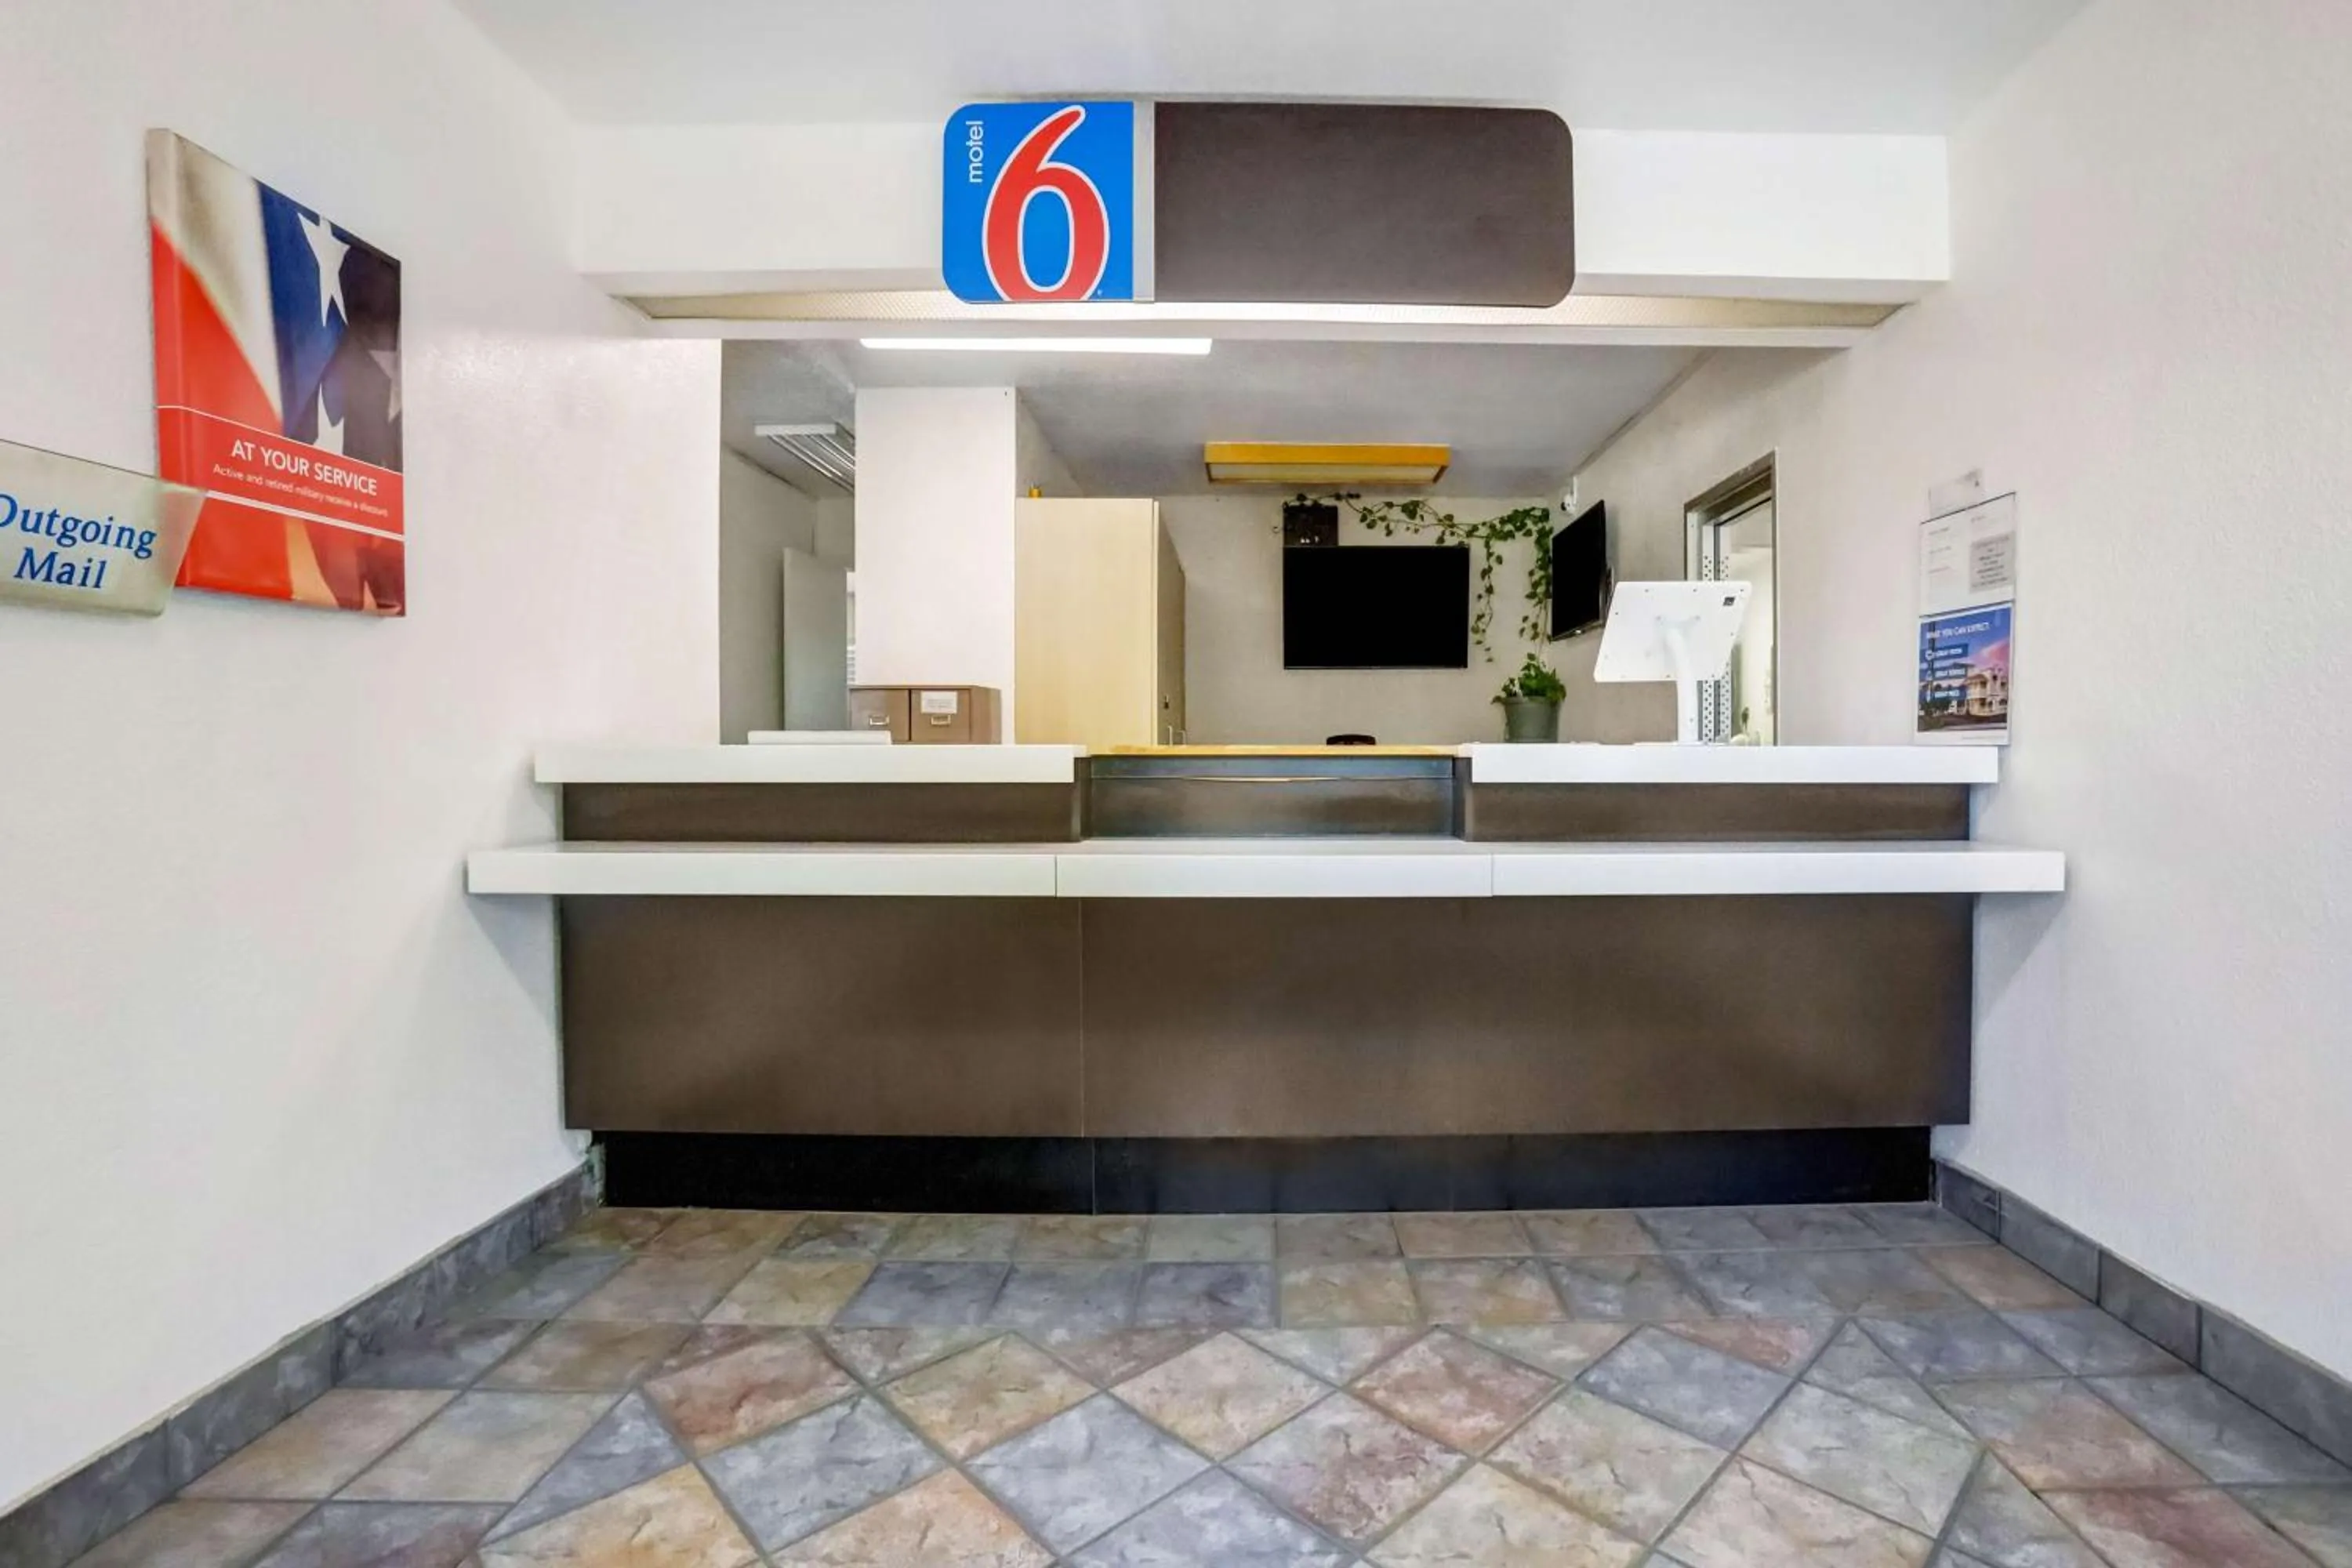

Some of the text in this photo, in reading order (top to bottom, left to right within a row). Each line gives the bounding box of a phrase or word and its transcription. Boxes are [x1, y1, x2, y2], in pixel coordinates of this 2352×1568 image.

[965, 120, 984, 183] motel
[982, 104, 1111, 302] 6
[212, 463, 244, 481] Active
[245, 474, 264, 486] and
[231, 438, 377, 496] AT YOUR SERVICE
[0, 494, 158, 560] Outgoing
[13, 546, 107, 589] Mail
